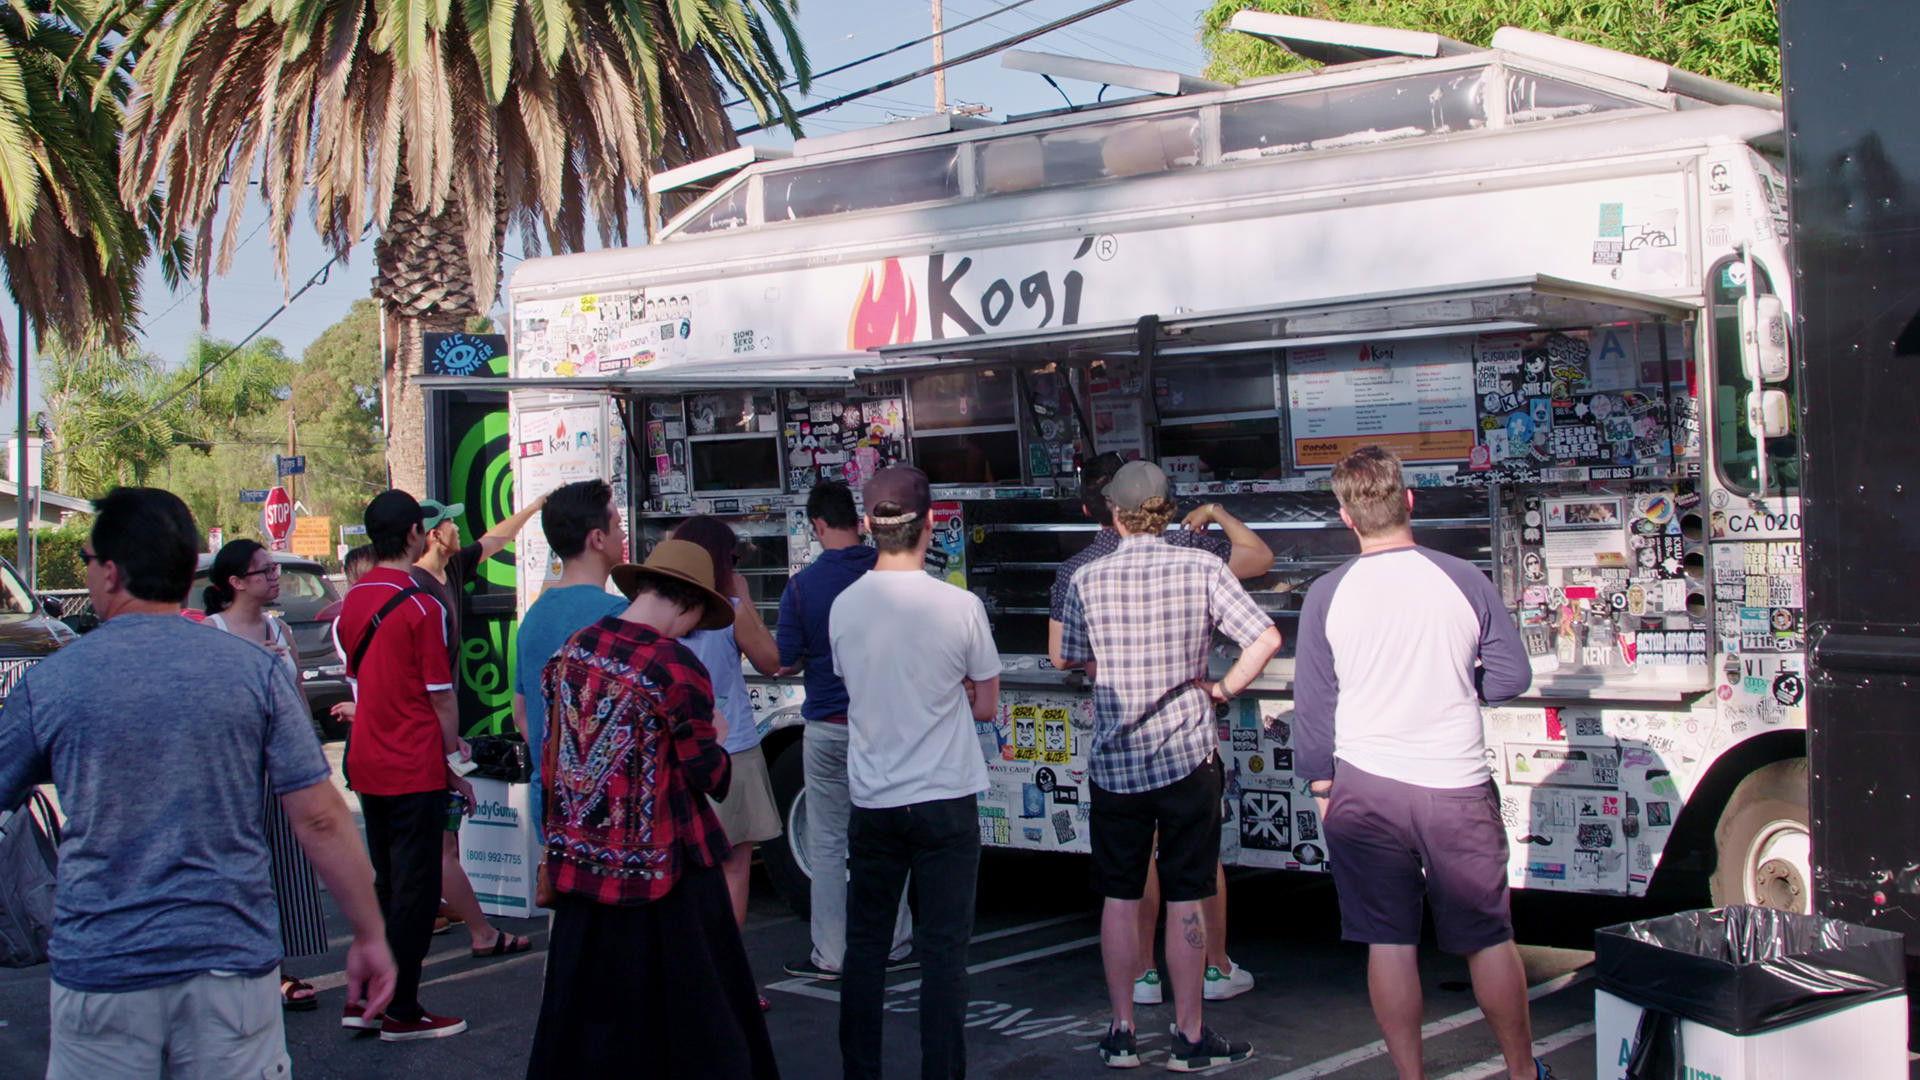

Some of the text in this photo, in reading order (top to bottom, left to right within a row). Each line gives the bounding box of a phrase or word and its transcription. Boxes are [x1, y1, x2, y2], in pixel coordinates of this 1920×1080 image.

[1599, 330, 1625, 360] A
[267, 503, 291, 525] STOP
[1728, 514, 1759, 532] CA
[1583, 647, 1612, 665] KENT
[474, 800, 519, 822] ndyGump
[1602, 806, 1618, 815] BG
